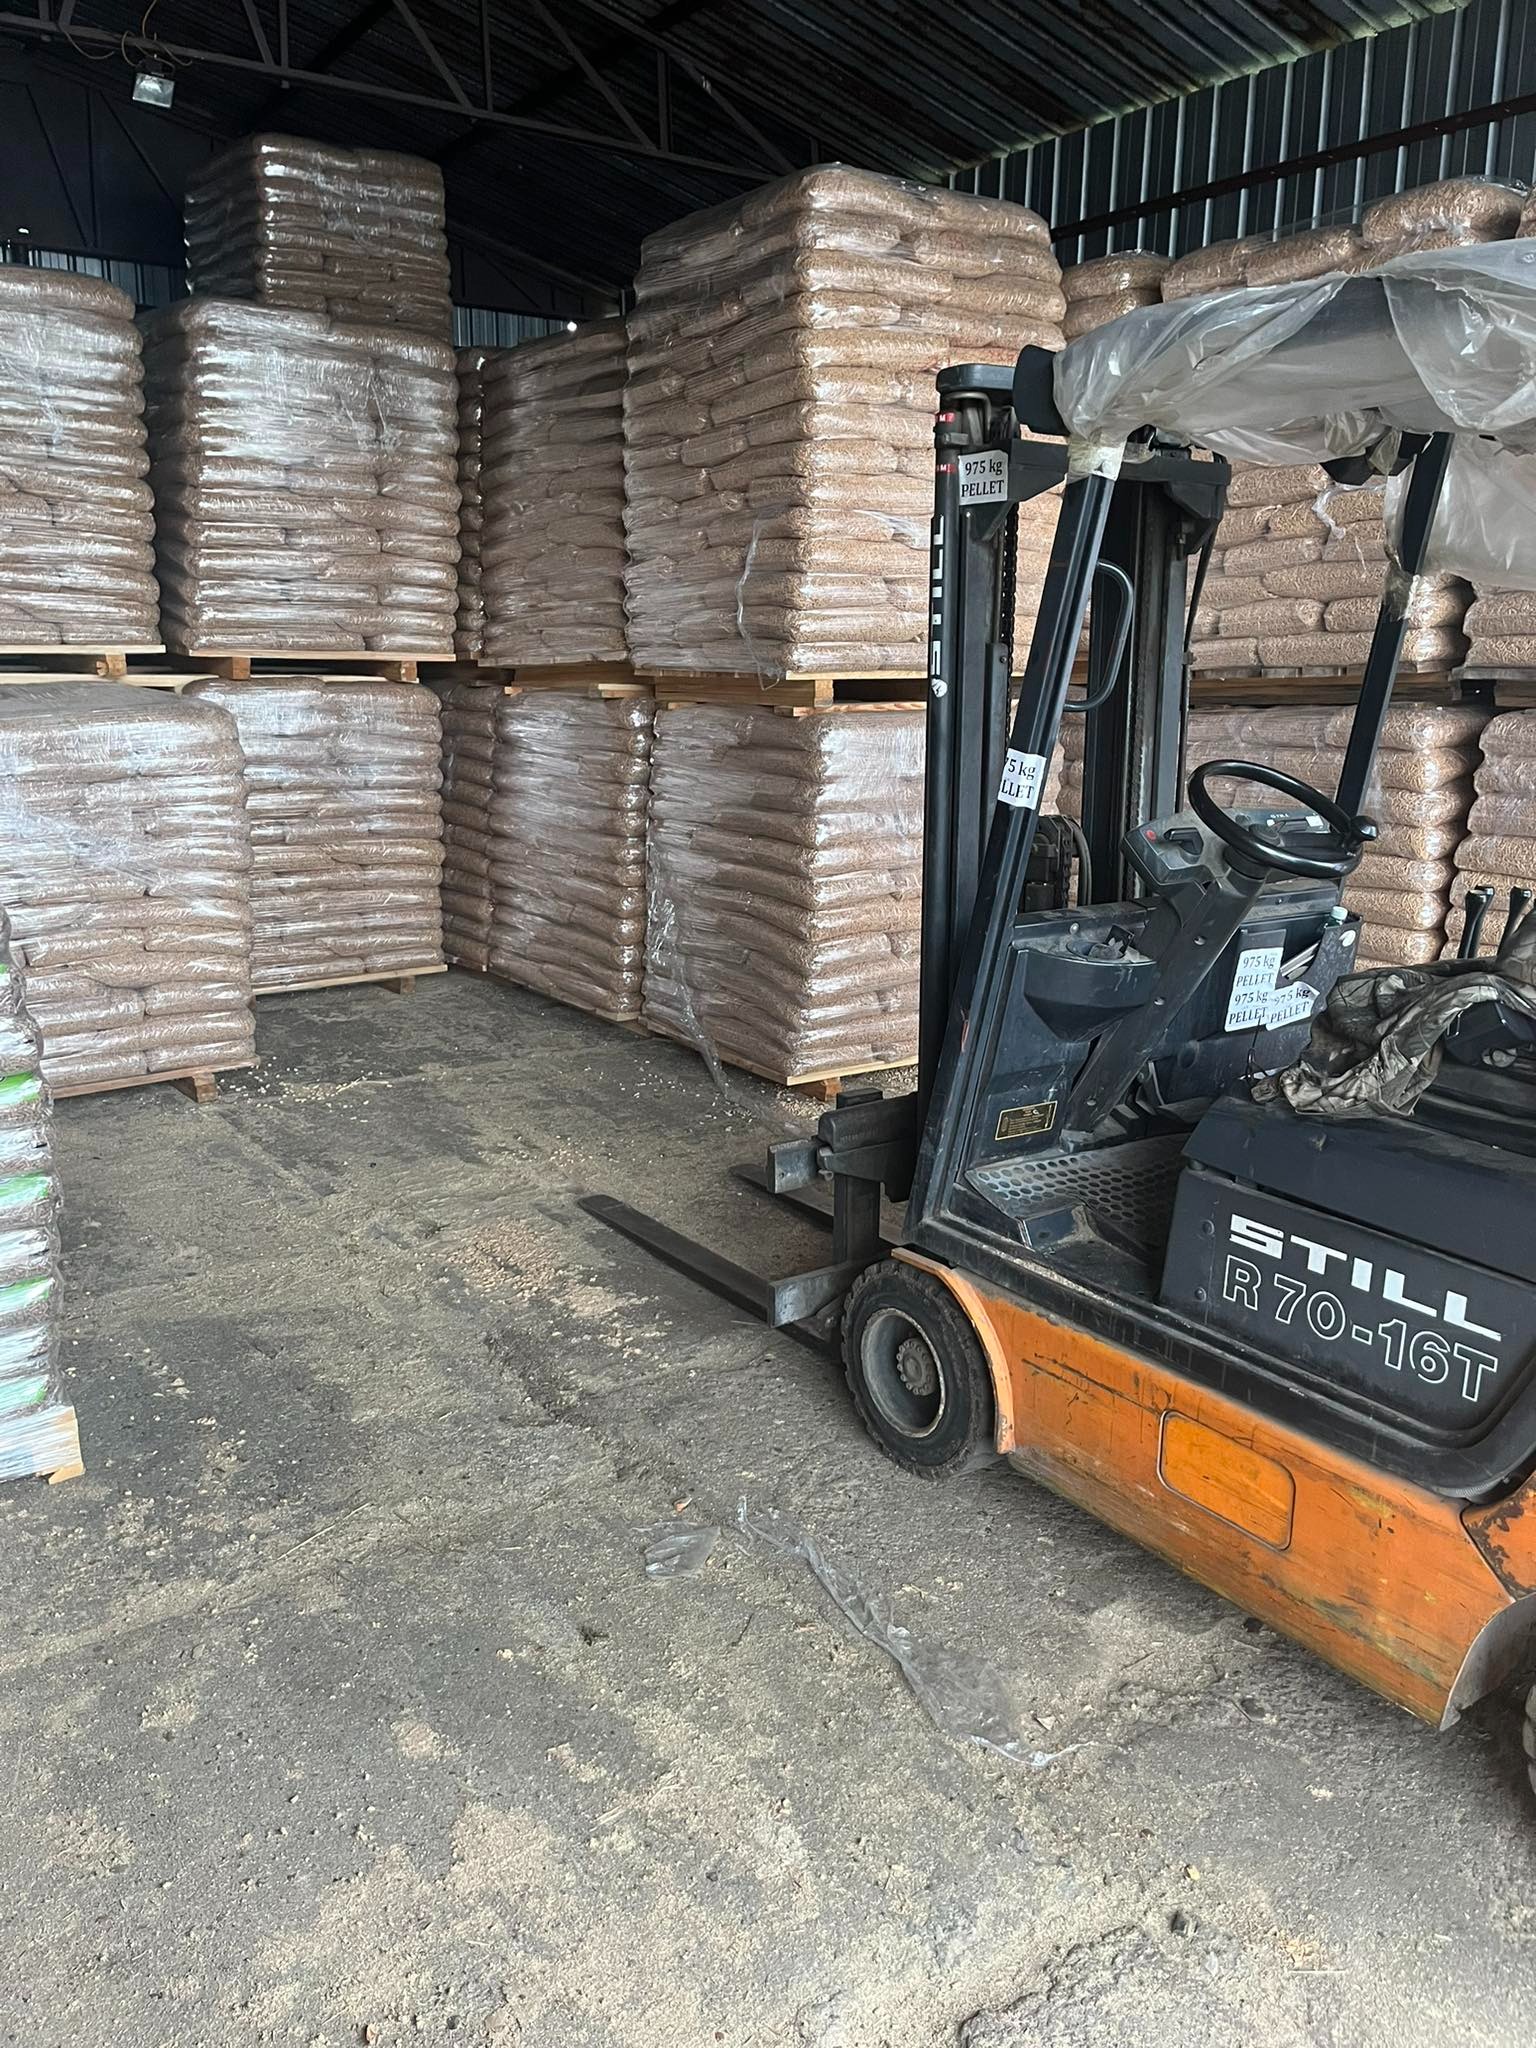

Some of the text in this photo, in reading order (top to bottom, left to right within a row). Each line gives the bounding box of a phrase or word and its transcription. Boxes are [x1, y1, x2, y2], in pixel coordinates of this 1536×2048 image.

[965, 460, 986, 476] 975
[989, 458, 1003, 476] kg
[961, 479, 1004, 498] PELLET
[1018, 761, 1036, 781] kg
[1243, 954, 1275, 969] 975 kg
[1236, 972, 1275, 988] PELLET
[1234, 990, 1269, 1006] 975 kg
[1295, 987, 1310, 999] kg
[1229, 1006, 1268, 1025] PELLET
[1270, 1001, 1310, 1023] PELLET
[1230, 1214, 1502, 1341] STILL
[1223, 1255, 1498, 1402] R 70-16T
